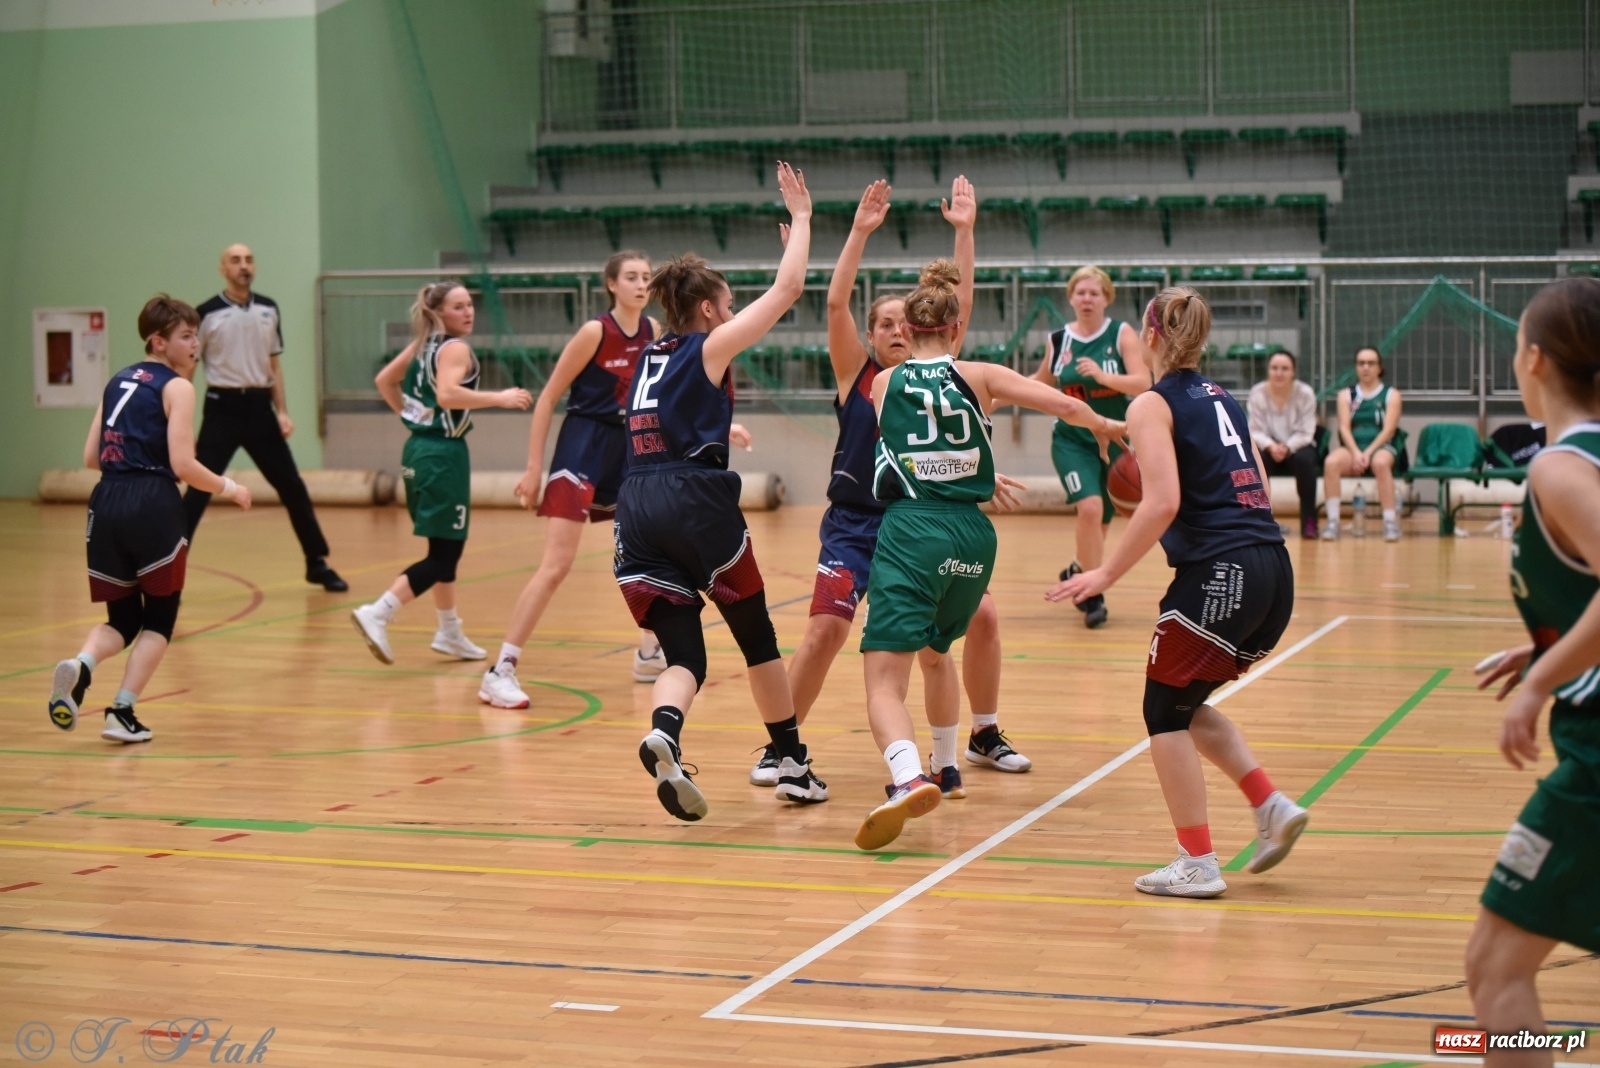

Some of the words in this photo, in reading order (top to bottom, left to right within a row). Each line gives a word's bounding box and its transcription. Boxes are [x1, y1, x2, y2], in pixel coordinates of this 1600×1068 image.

[632, 355, 670, 411] 12
[106, 381, 139, 427] 7
[904, 383, 971, 446] 35
[1213, 400, 1248, 462] 4
[916, 460, 977, 476] WAGTECH
[1064, 471, 1082, 496] 10
[452, 505, 467, 530] 3
[1235, 570, 1244, 602] PASSION
[1149, 635, 1159, 665] 4
